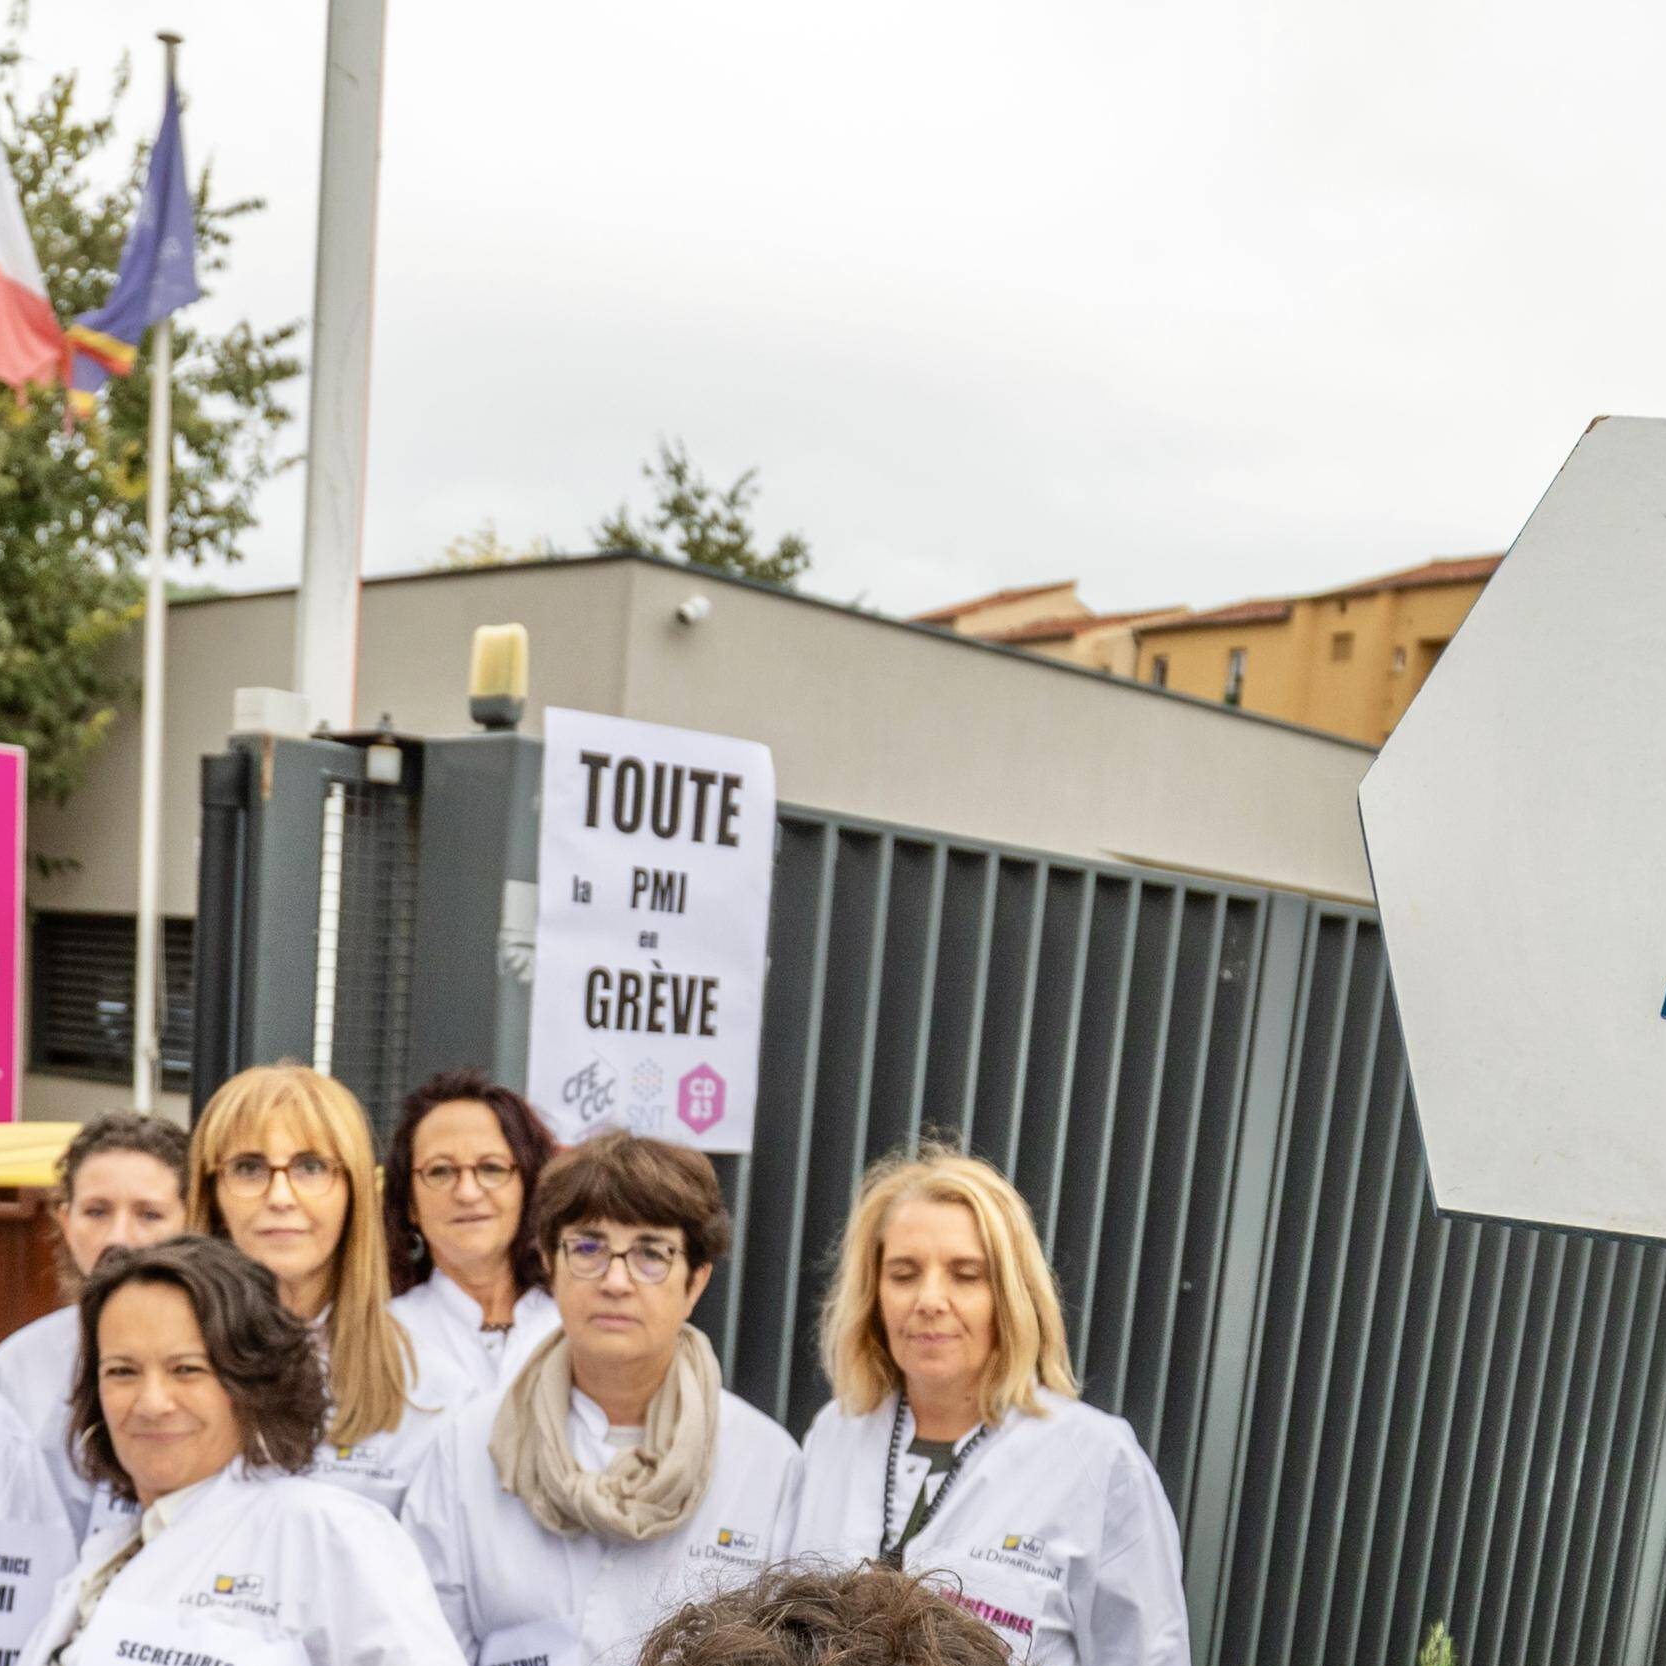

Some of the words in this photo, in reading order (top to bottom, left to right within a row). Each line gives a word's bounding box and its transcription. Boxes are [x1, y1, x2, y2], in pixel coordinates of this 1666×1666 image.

[579, 749, 744, 848] TOUTE
[572, 875, 592, 905] la
[629, 866, 688, 915] PMI
[638, 928, 658, 949] en
[585, 959, 720, 1038] GRÈVE
[689, 1078, 717, 1098] CD
